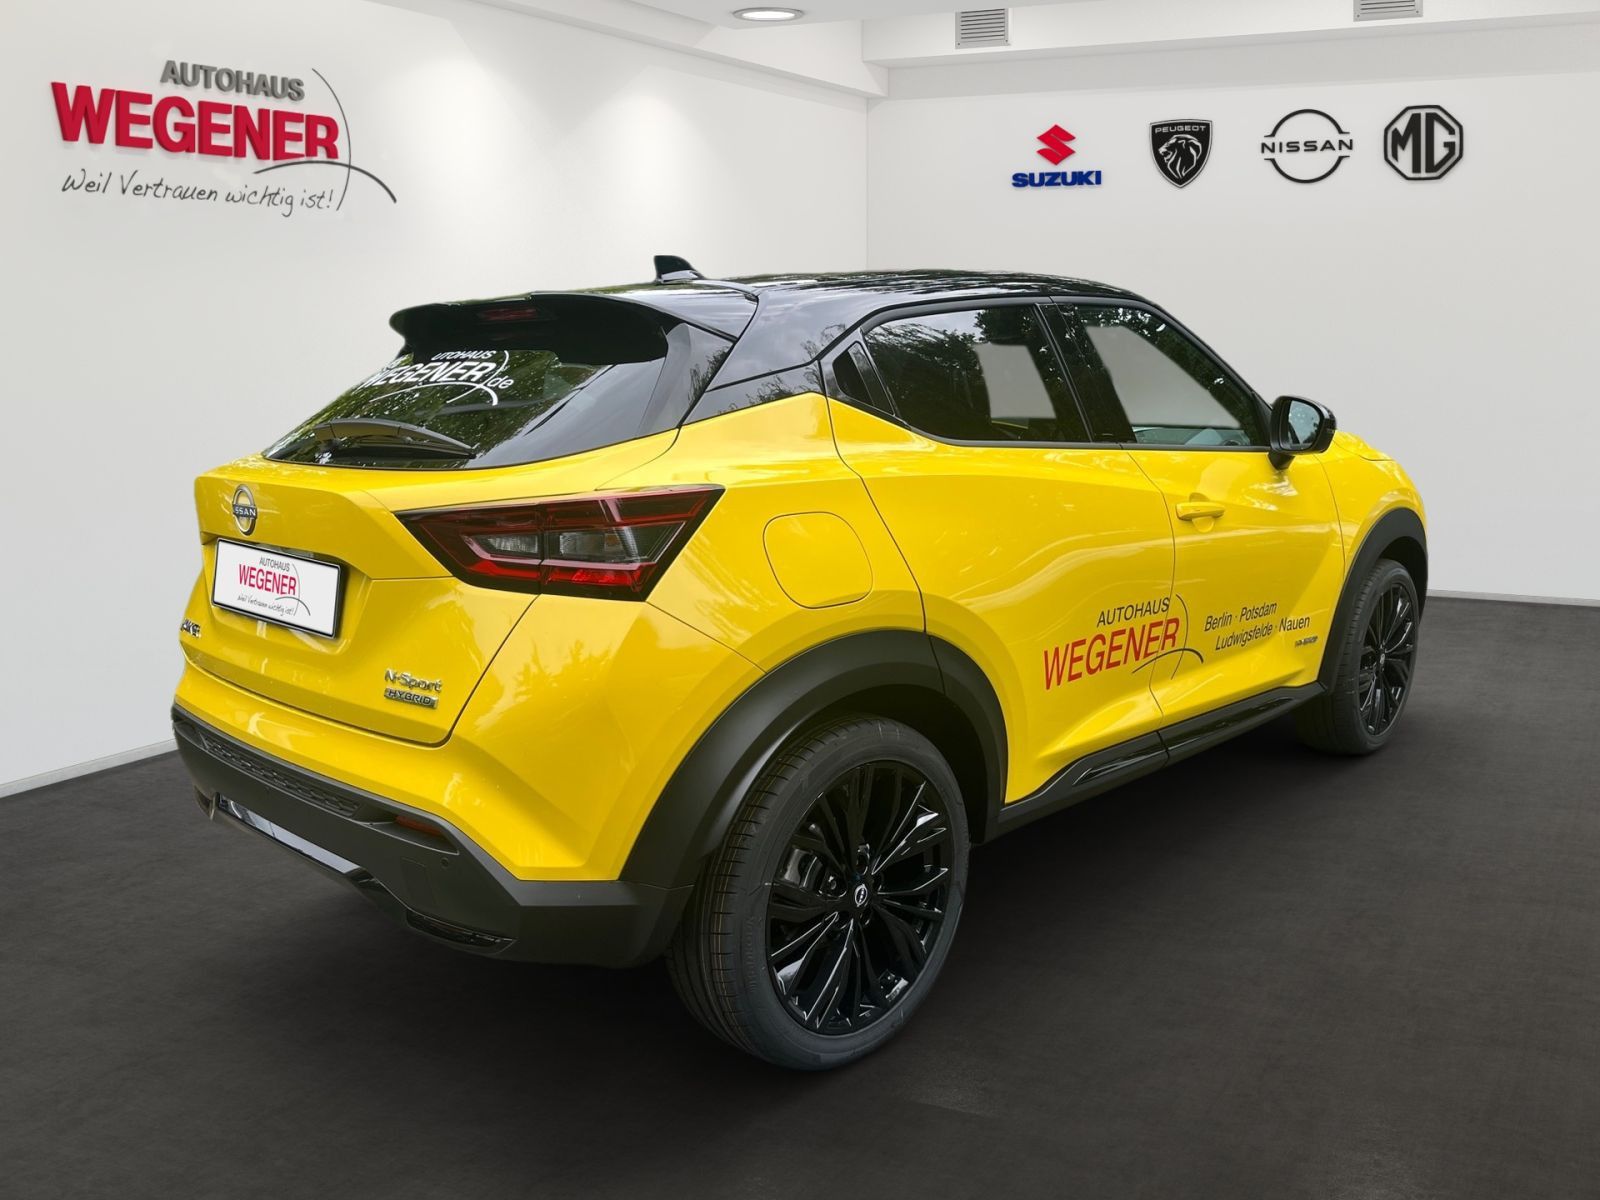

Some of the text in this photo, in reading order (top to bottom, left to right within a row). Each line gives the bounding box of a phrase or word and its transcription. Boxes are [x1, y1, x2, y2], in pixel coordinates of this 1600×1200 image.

[160, 60, 305, 101] AUTOHAUS
[51, 81, 339, 161] WEGENER
[1154, 124, 1207, 133] PEUGEOT
[1261, 138, 1354, 155] NISSAN
[1391, 112, 1456, 174] MG
[62, 168, 334, 217] Weil Vertrauen wichtig ist!
[1011, 170, 1102, 188] SUZUKI
[430, 349, 497, 361] UTOHAUS
[239, 564, 297, 595] WEGENER
[259, 557, 290, 572] AUTOHAUS
[1096, 597, 1170, 627] AUTOHAUS
[1204, 602, 1278, 632] Berlin Potsdam
[1215, 622, 1273, 651] Ludwigsfelde
[1278, 615, 1311, 632] Nauen
[1043, 617, 1180, 690] WEGENER
[387, 689, 432, 705] HYBRID
